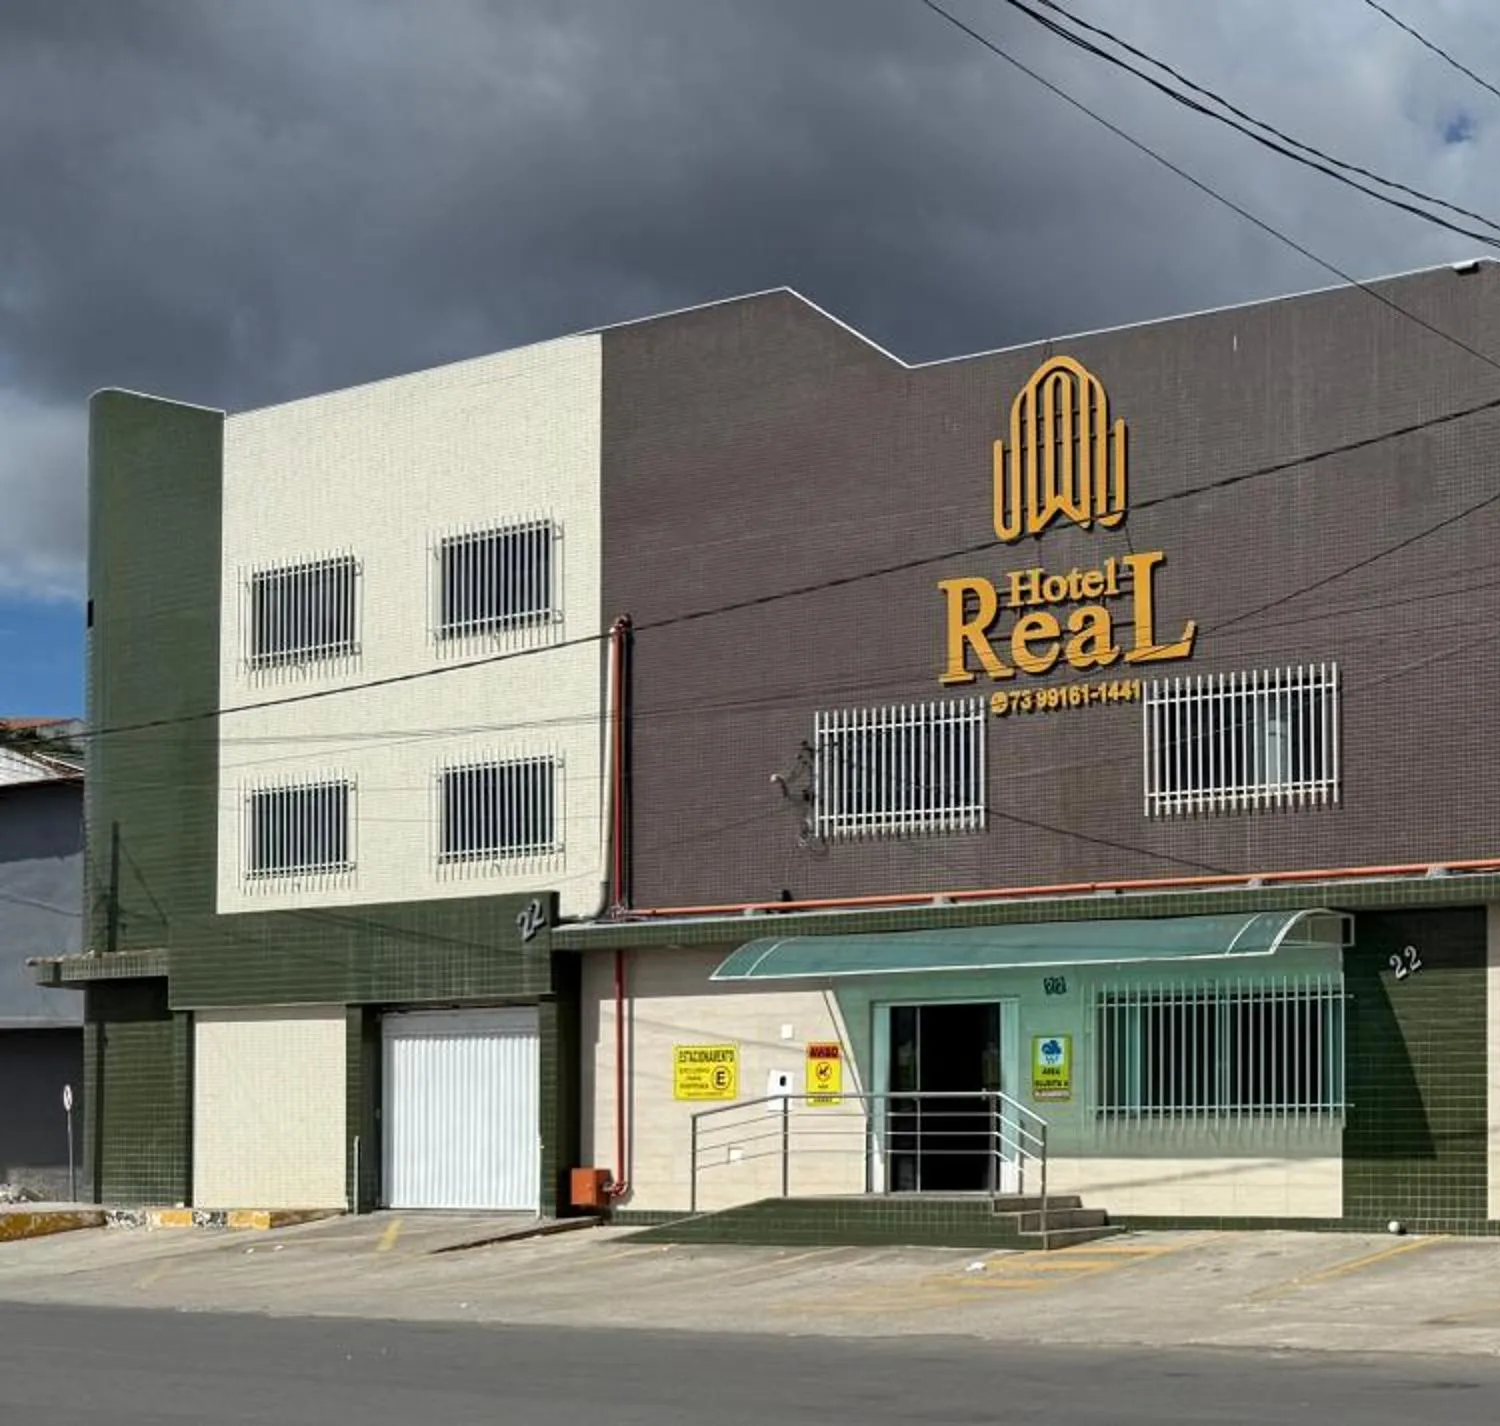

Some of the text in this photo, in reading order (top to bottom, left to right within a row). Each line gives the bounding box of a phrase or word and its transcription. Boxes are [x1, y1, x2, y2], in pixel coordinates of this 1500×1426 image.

[1006, 557, 1120, 608] Hotel
[1008, 678, 1141, 711] 73 99161-1441
[516, 898, 545, 941] 22
[1389, 945, 1422, 979] 22
[717, 1071, 726, 1086] E
